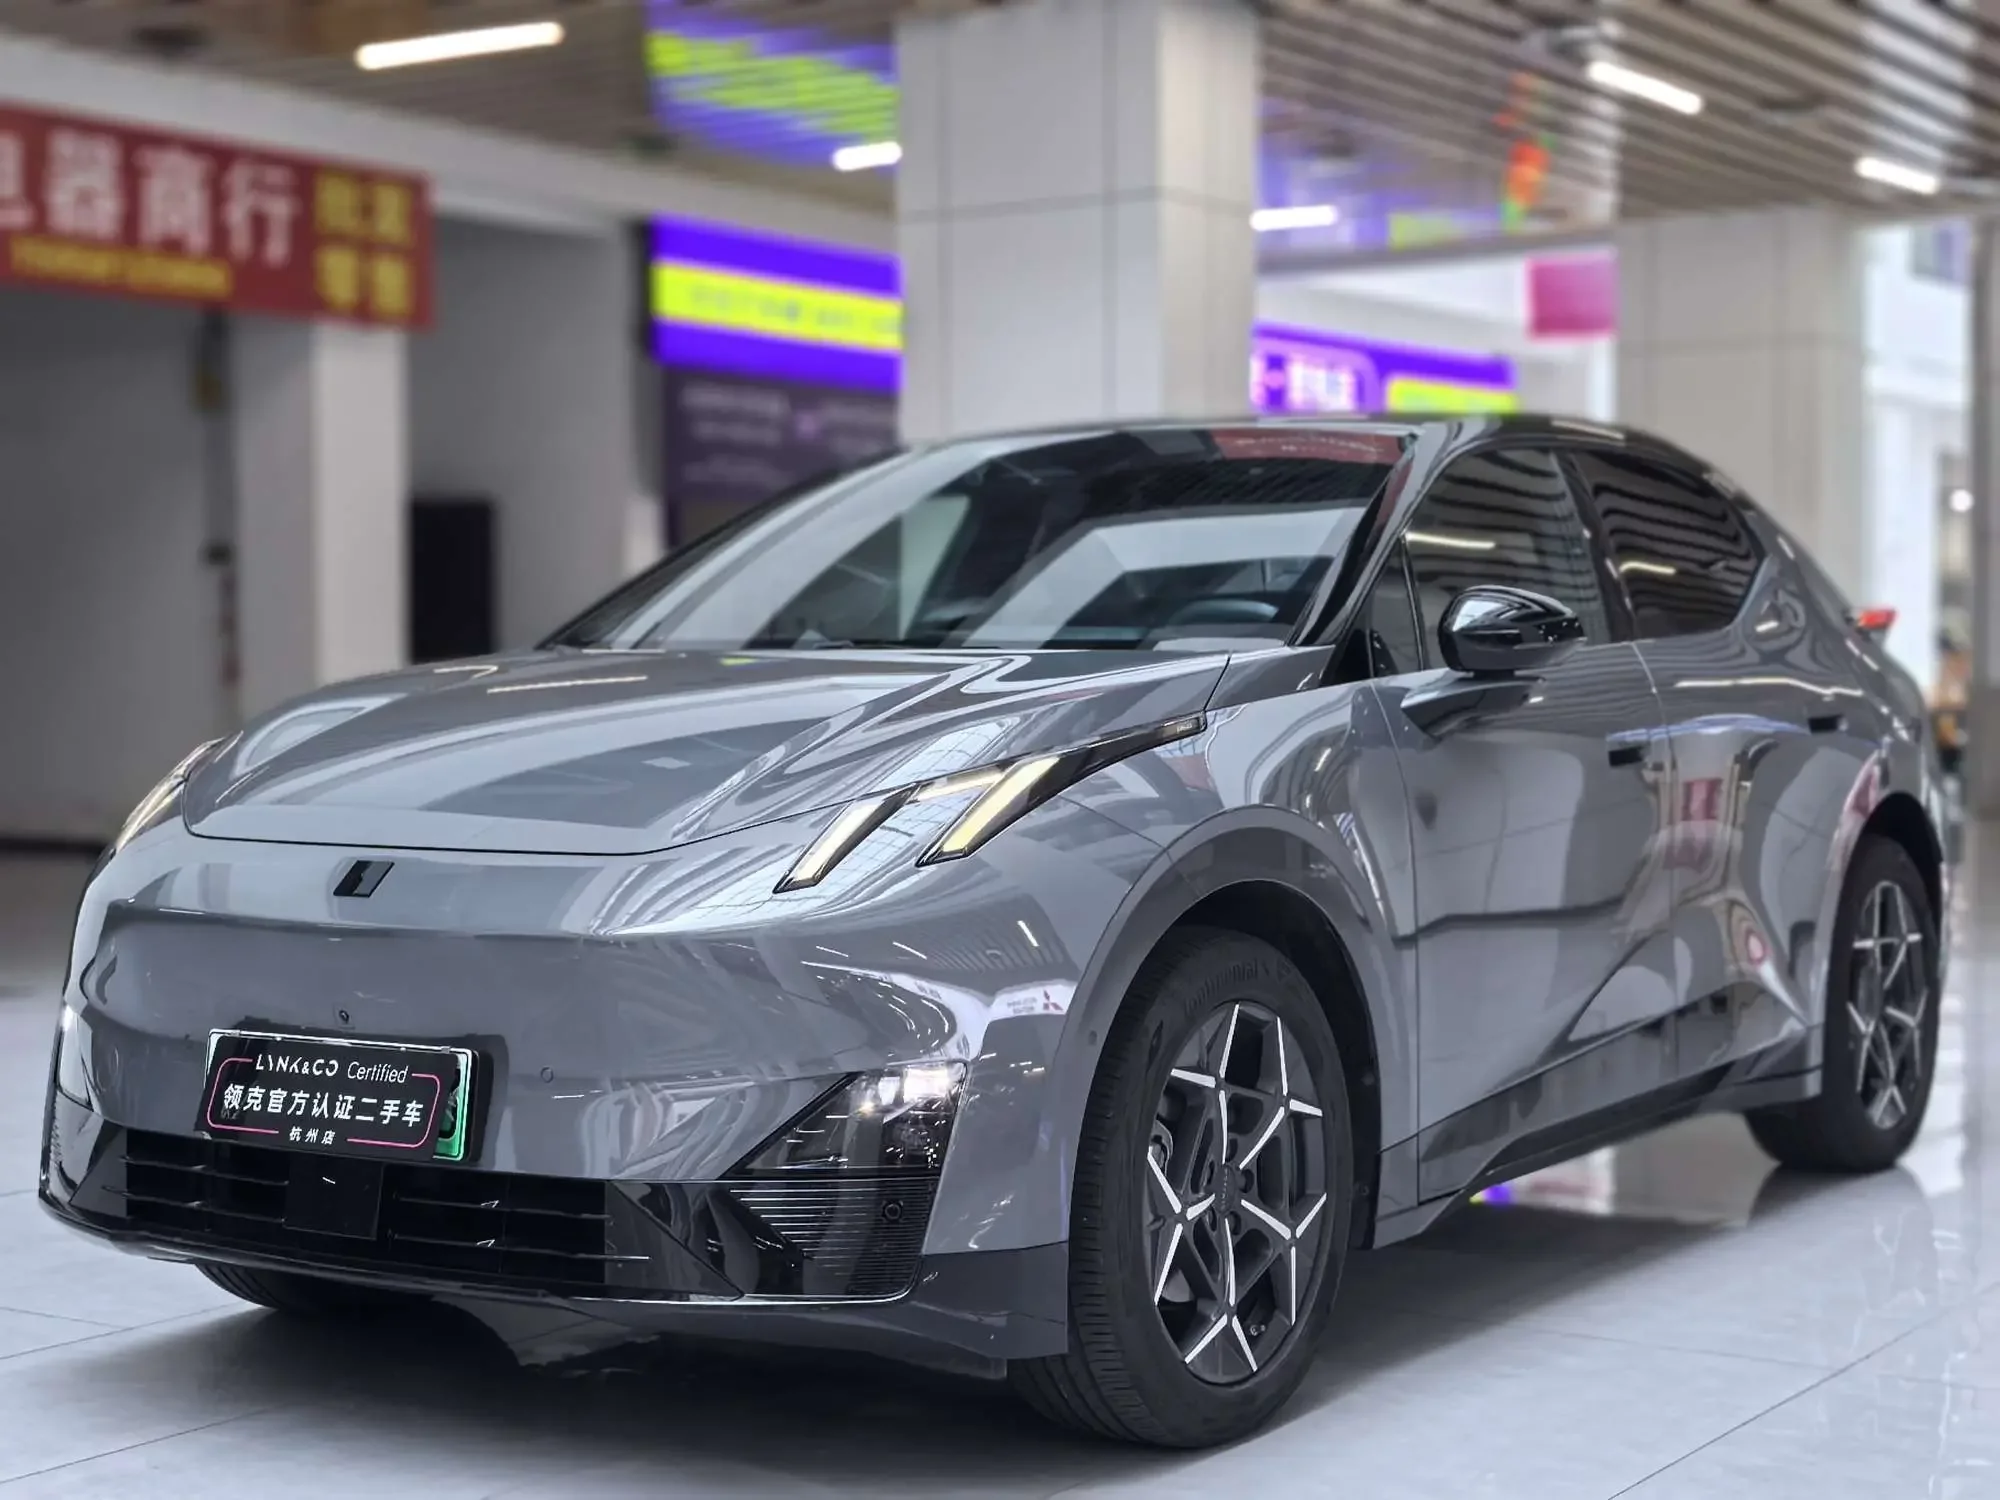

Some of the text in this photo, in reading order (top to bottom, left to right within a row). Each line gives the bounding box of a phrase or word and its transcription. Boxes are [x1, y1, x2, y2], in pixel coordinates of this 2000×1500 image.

[255, 1053, 409, 1084] LYNK&CO Certified
[223, 1083, 424, 1128] 领克官方认证二手车
[289, 1126, 336, 1145] 杭州店
